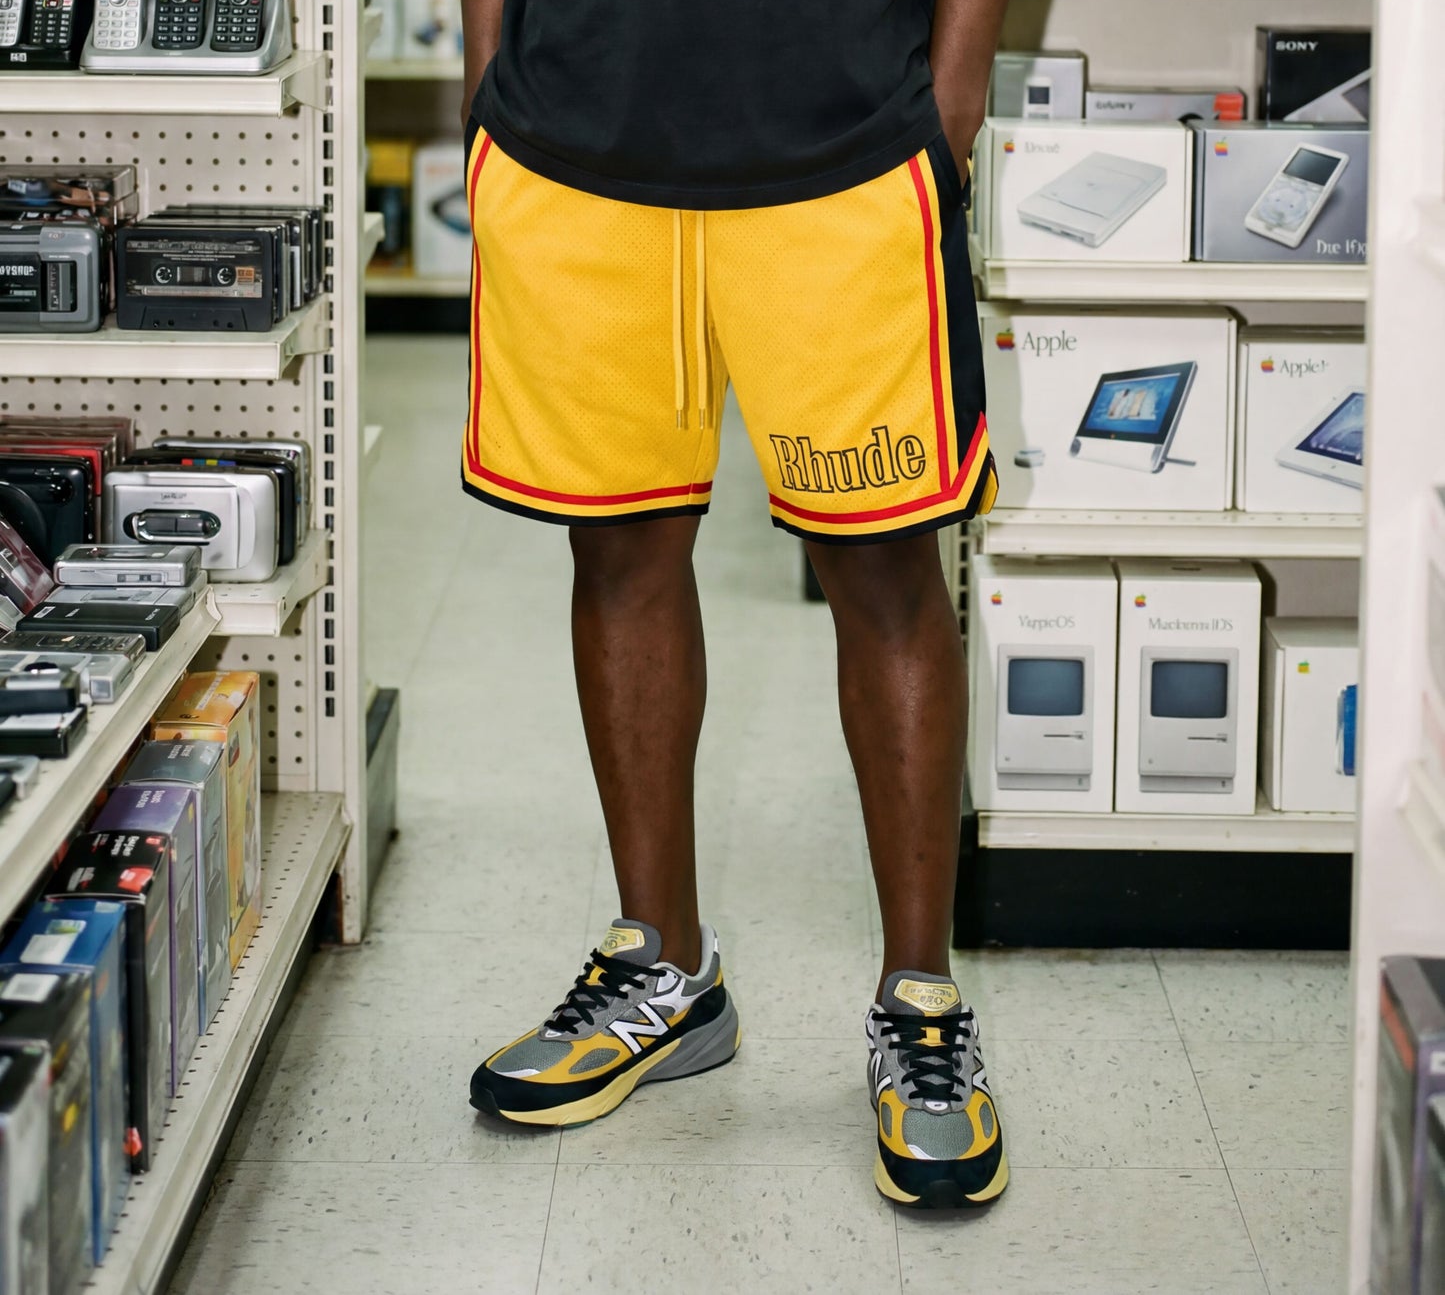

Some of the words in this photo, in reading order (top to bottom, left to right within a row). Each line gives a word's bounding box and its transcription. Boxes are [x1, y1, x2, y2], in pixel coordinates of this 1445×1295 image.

[1275, 40, 1319, 52] SONY
[1021, 329, 1078, 358] Apple
[769, 424, 927, 494] Rhude
